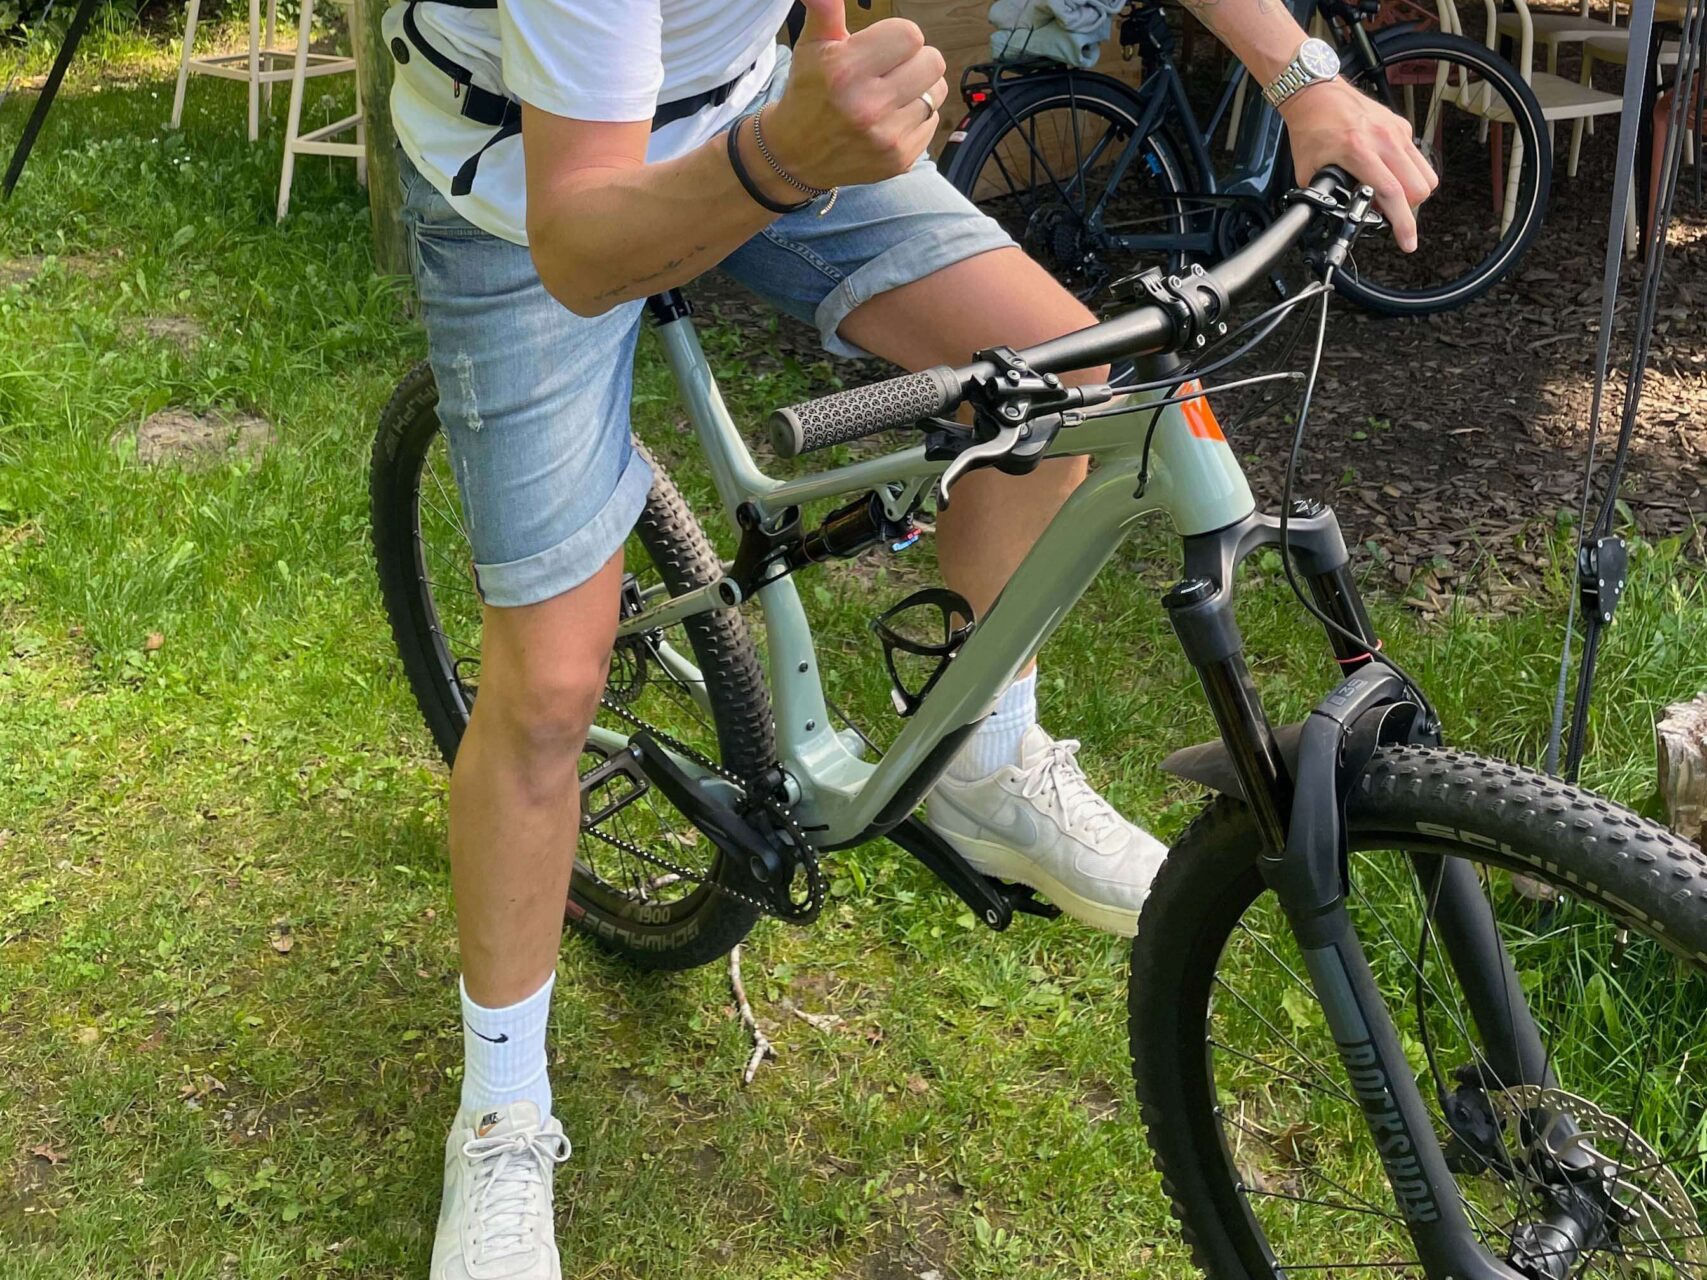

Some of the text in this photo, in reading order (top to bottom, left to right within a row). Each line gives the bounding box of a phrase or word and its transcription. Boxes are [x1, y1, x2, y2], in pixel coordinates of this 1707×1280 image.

[582, 912, 700, 953] SCHWALBE
[639, 906, 671, 924] 1900
[1340, 1043, 1440, 1222] ROCKSHOX
